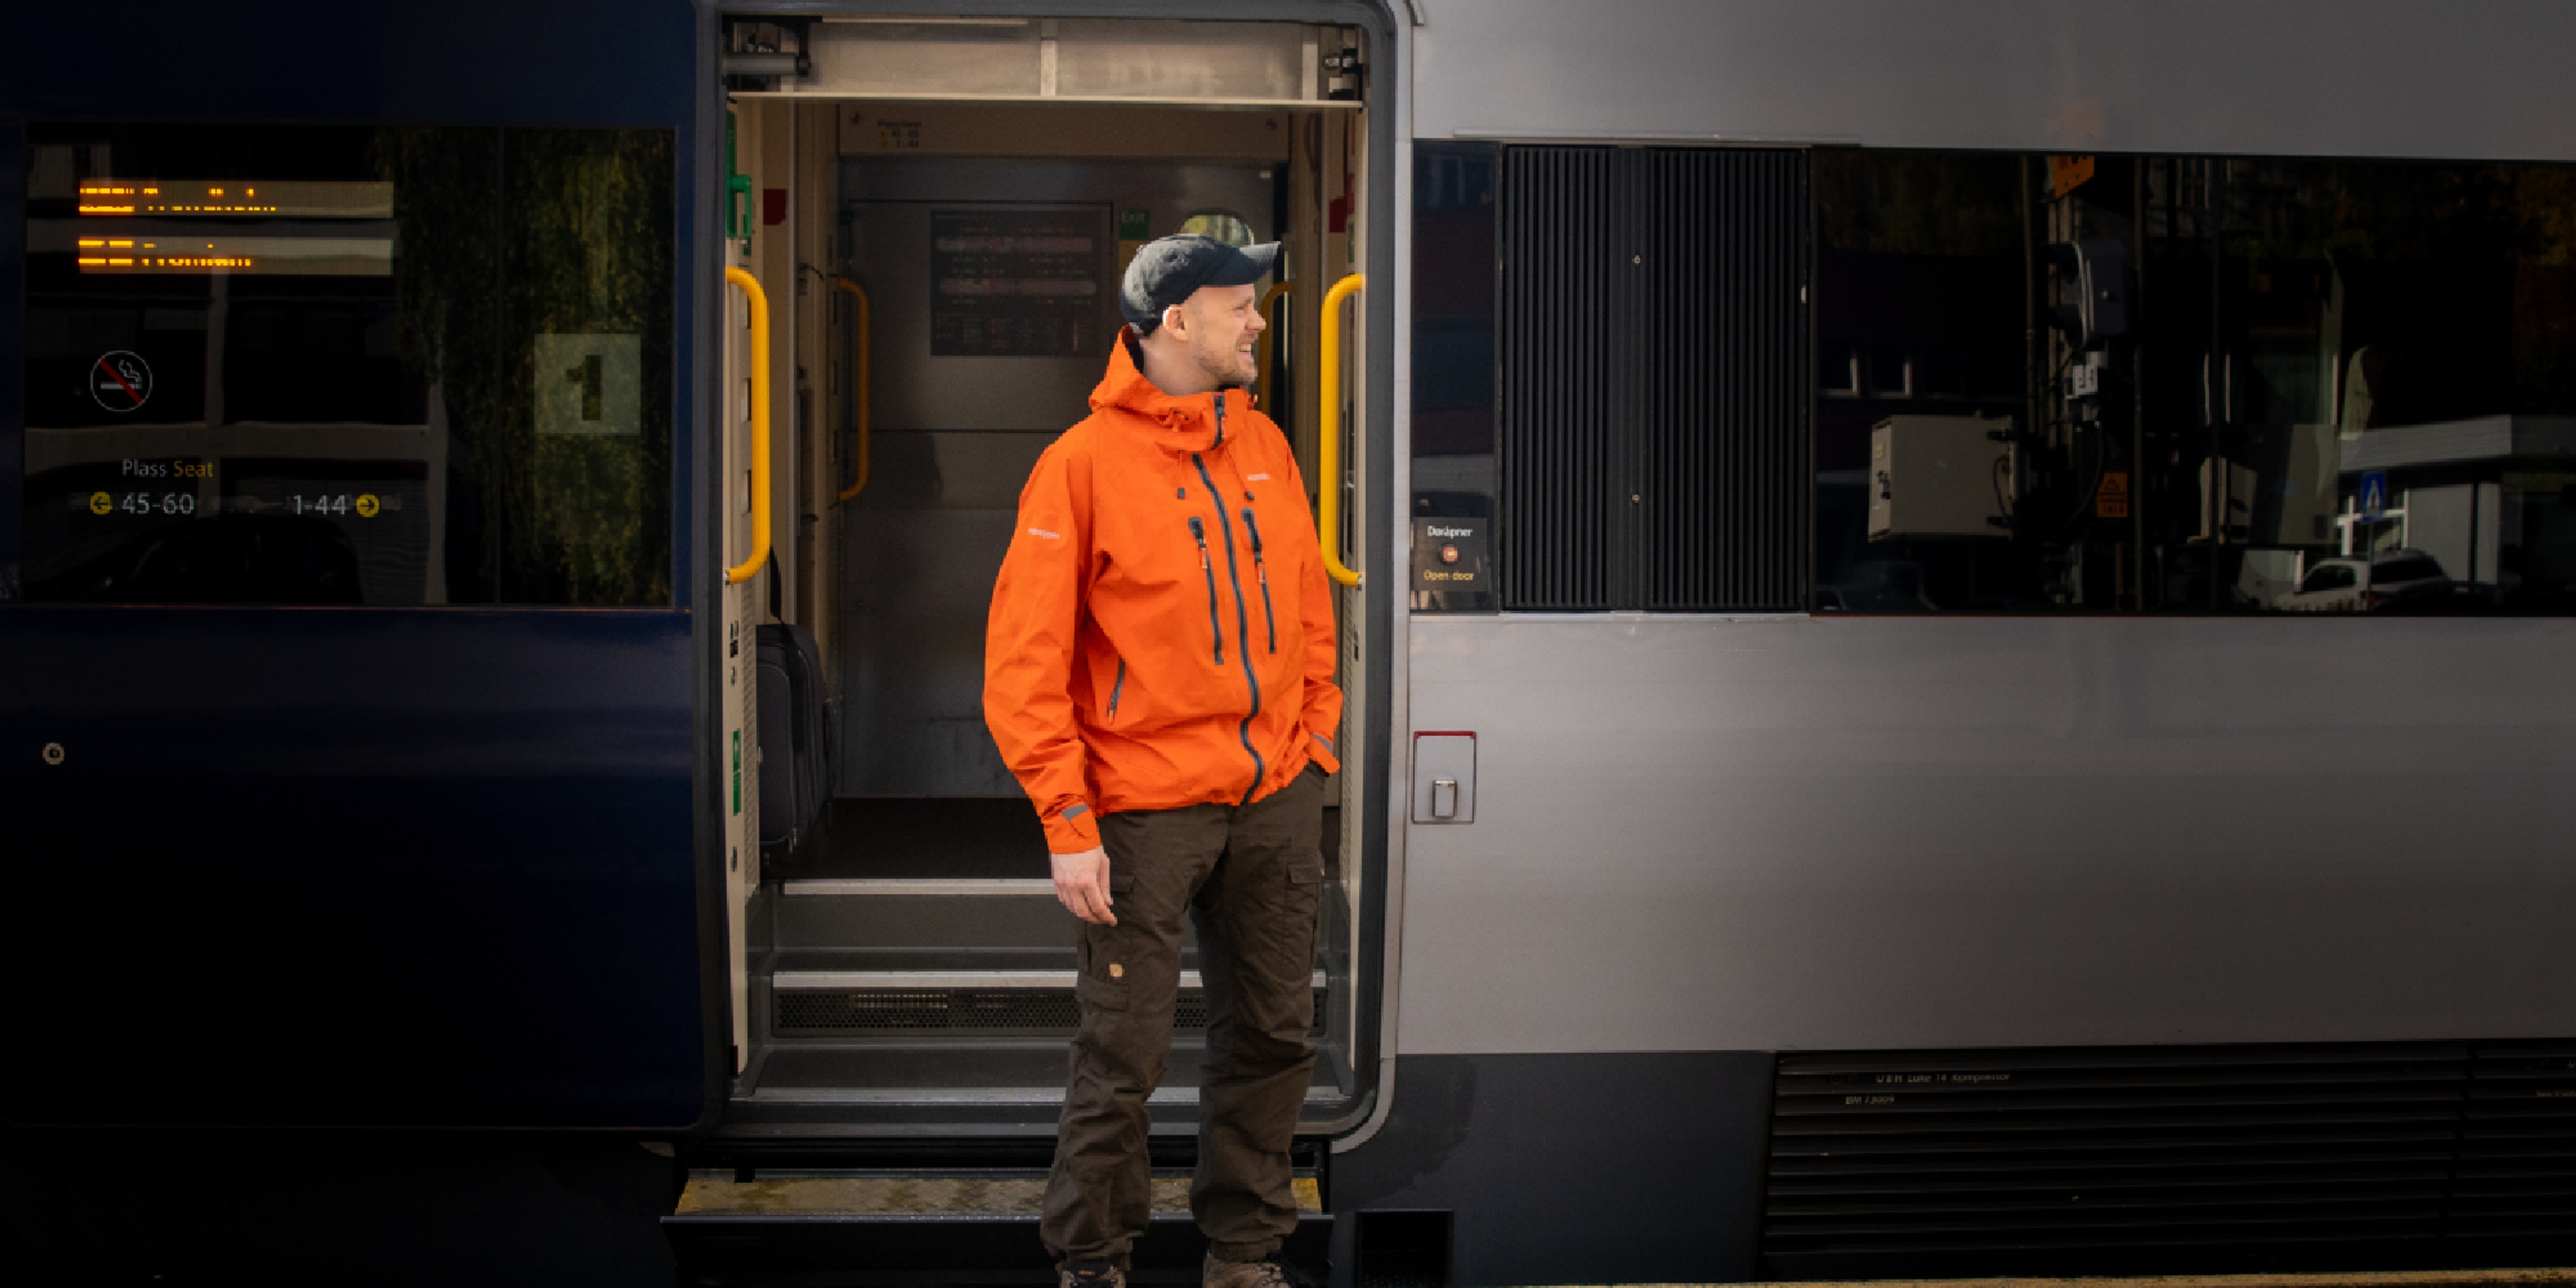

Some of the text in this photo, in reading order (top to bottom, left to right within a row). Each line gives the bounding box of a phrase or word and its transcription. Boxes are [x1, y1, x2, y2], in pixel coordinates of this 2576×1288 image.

[566, 354, 603, 421] 1
[122, 458, 213, 478] Plass Seat
[121, 492, 195, 515] 45-60
[293, 494, 346, 516] 1-44
[1424, 570, 1474, 581] Open door
